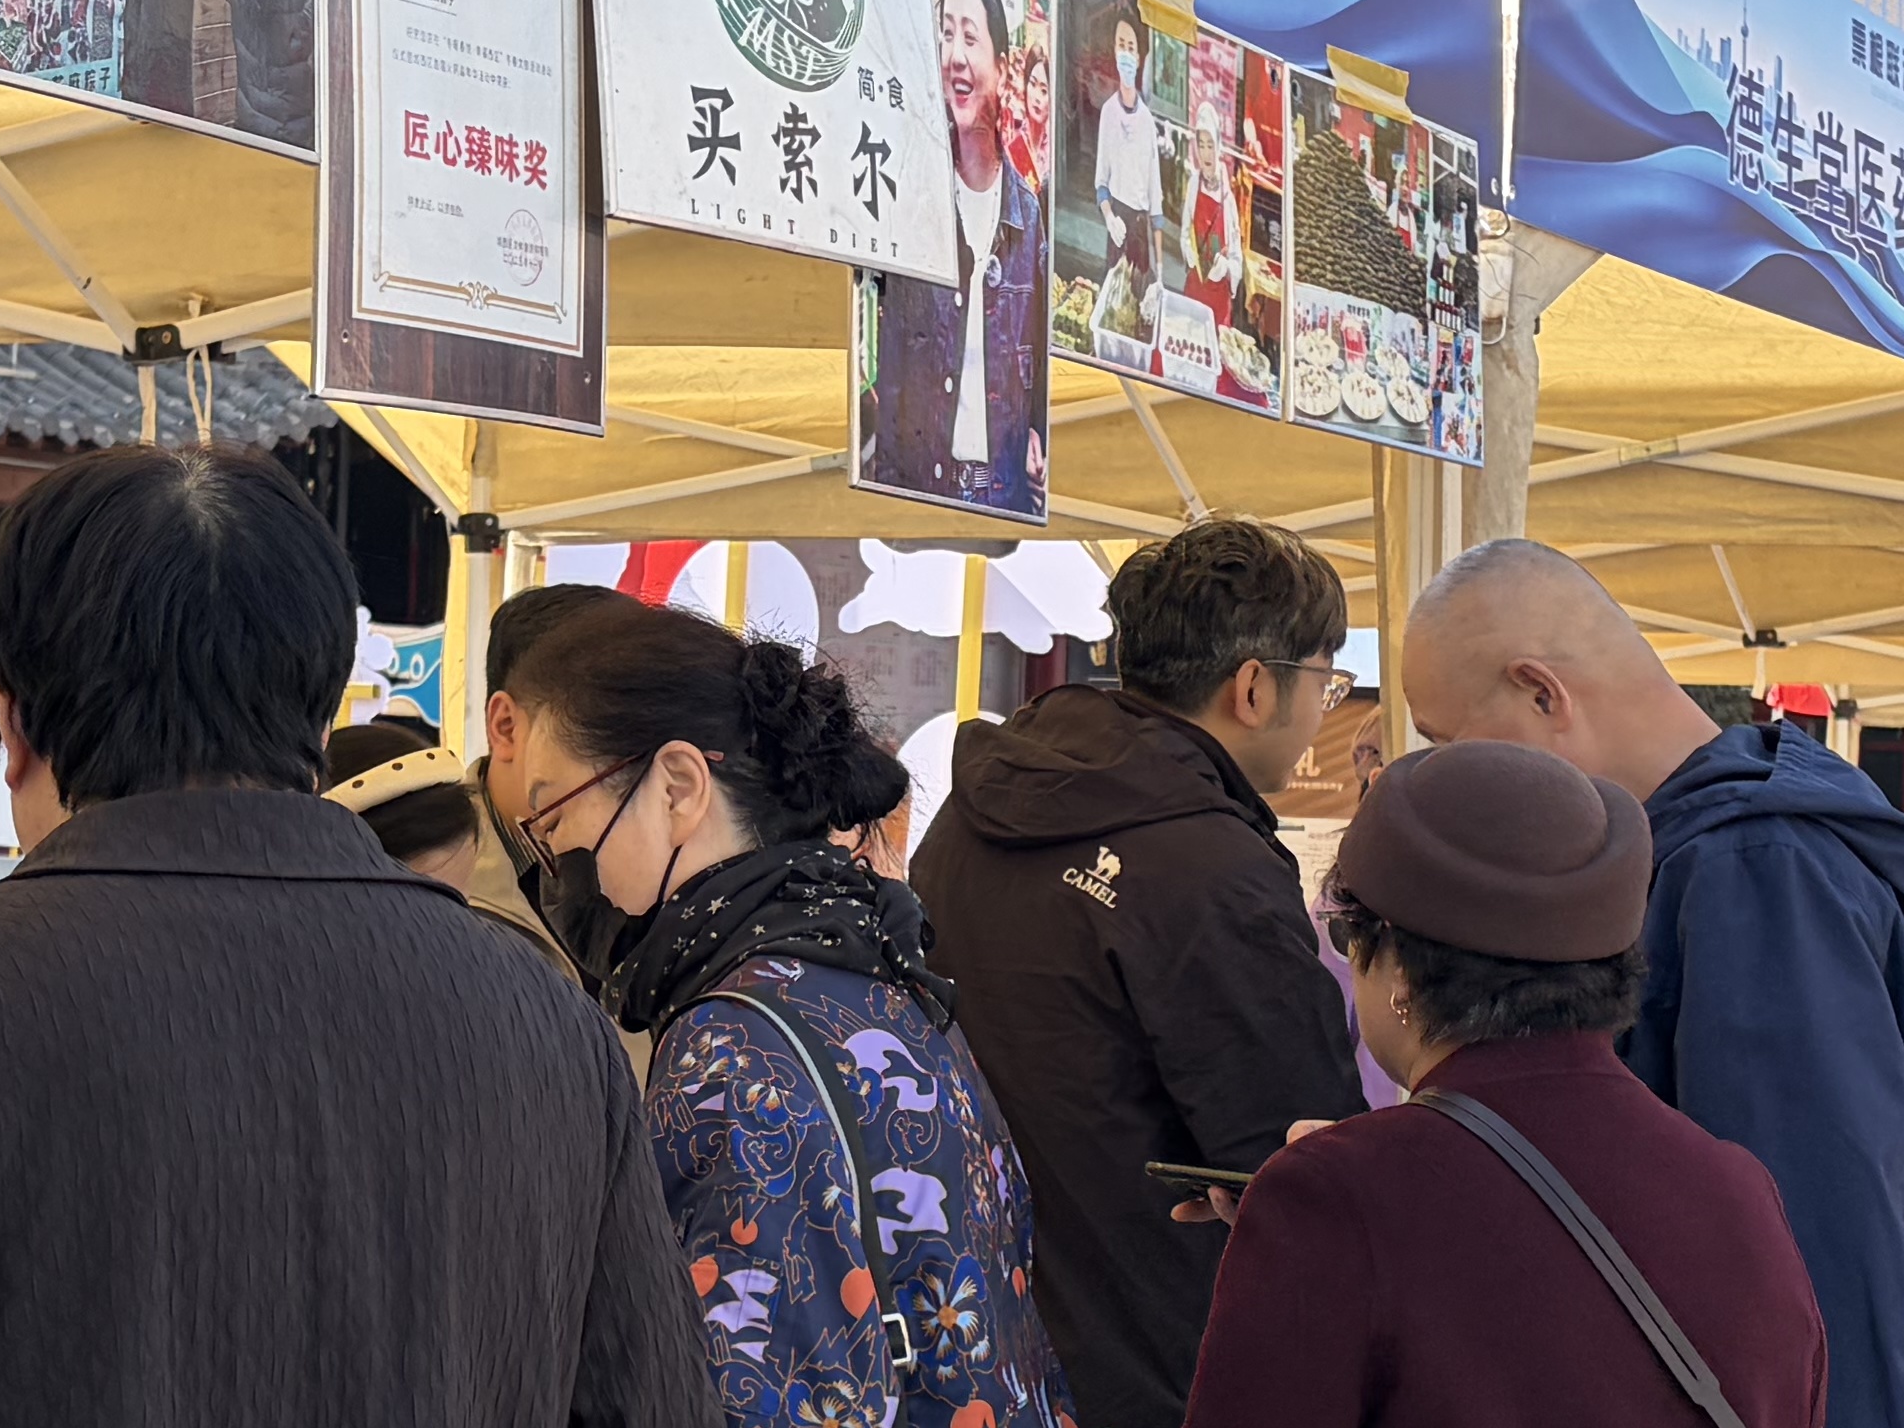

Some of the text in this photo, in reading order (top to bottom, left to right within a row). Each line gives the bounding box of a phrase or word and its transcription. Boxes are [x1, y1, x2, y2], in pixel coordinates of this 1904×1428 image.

[403, 109, 548, 191] 匠心臻味奖
[686, 84, 898, 222] 买索尔
[691, 197, 900, 259] LIGHT DIET
[1062, 867, 1118, 909] CAMEL
